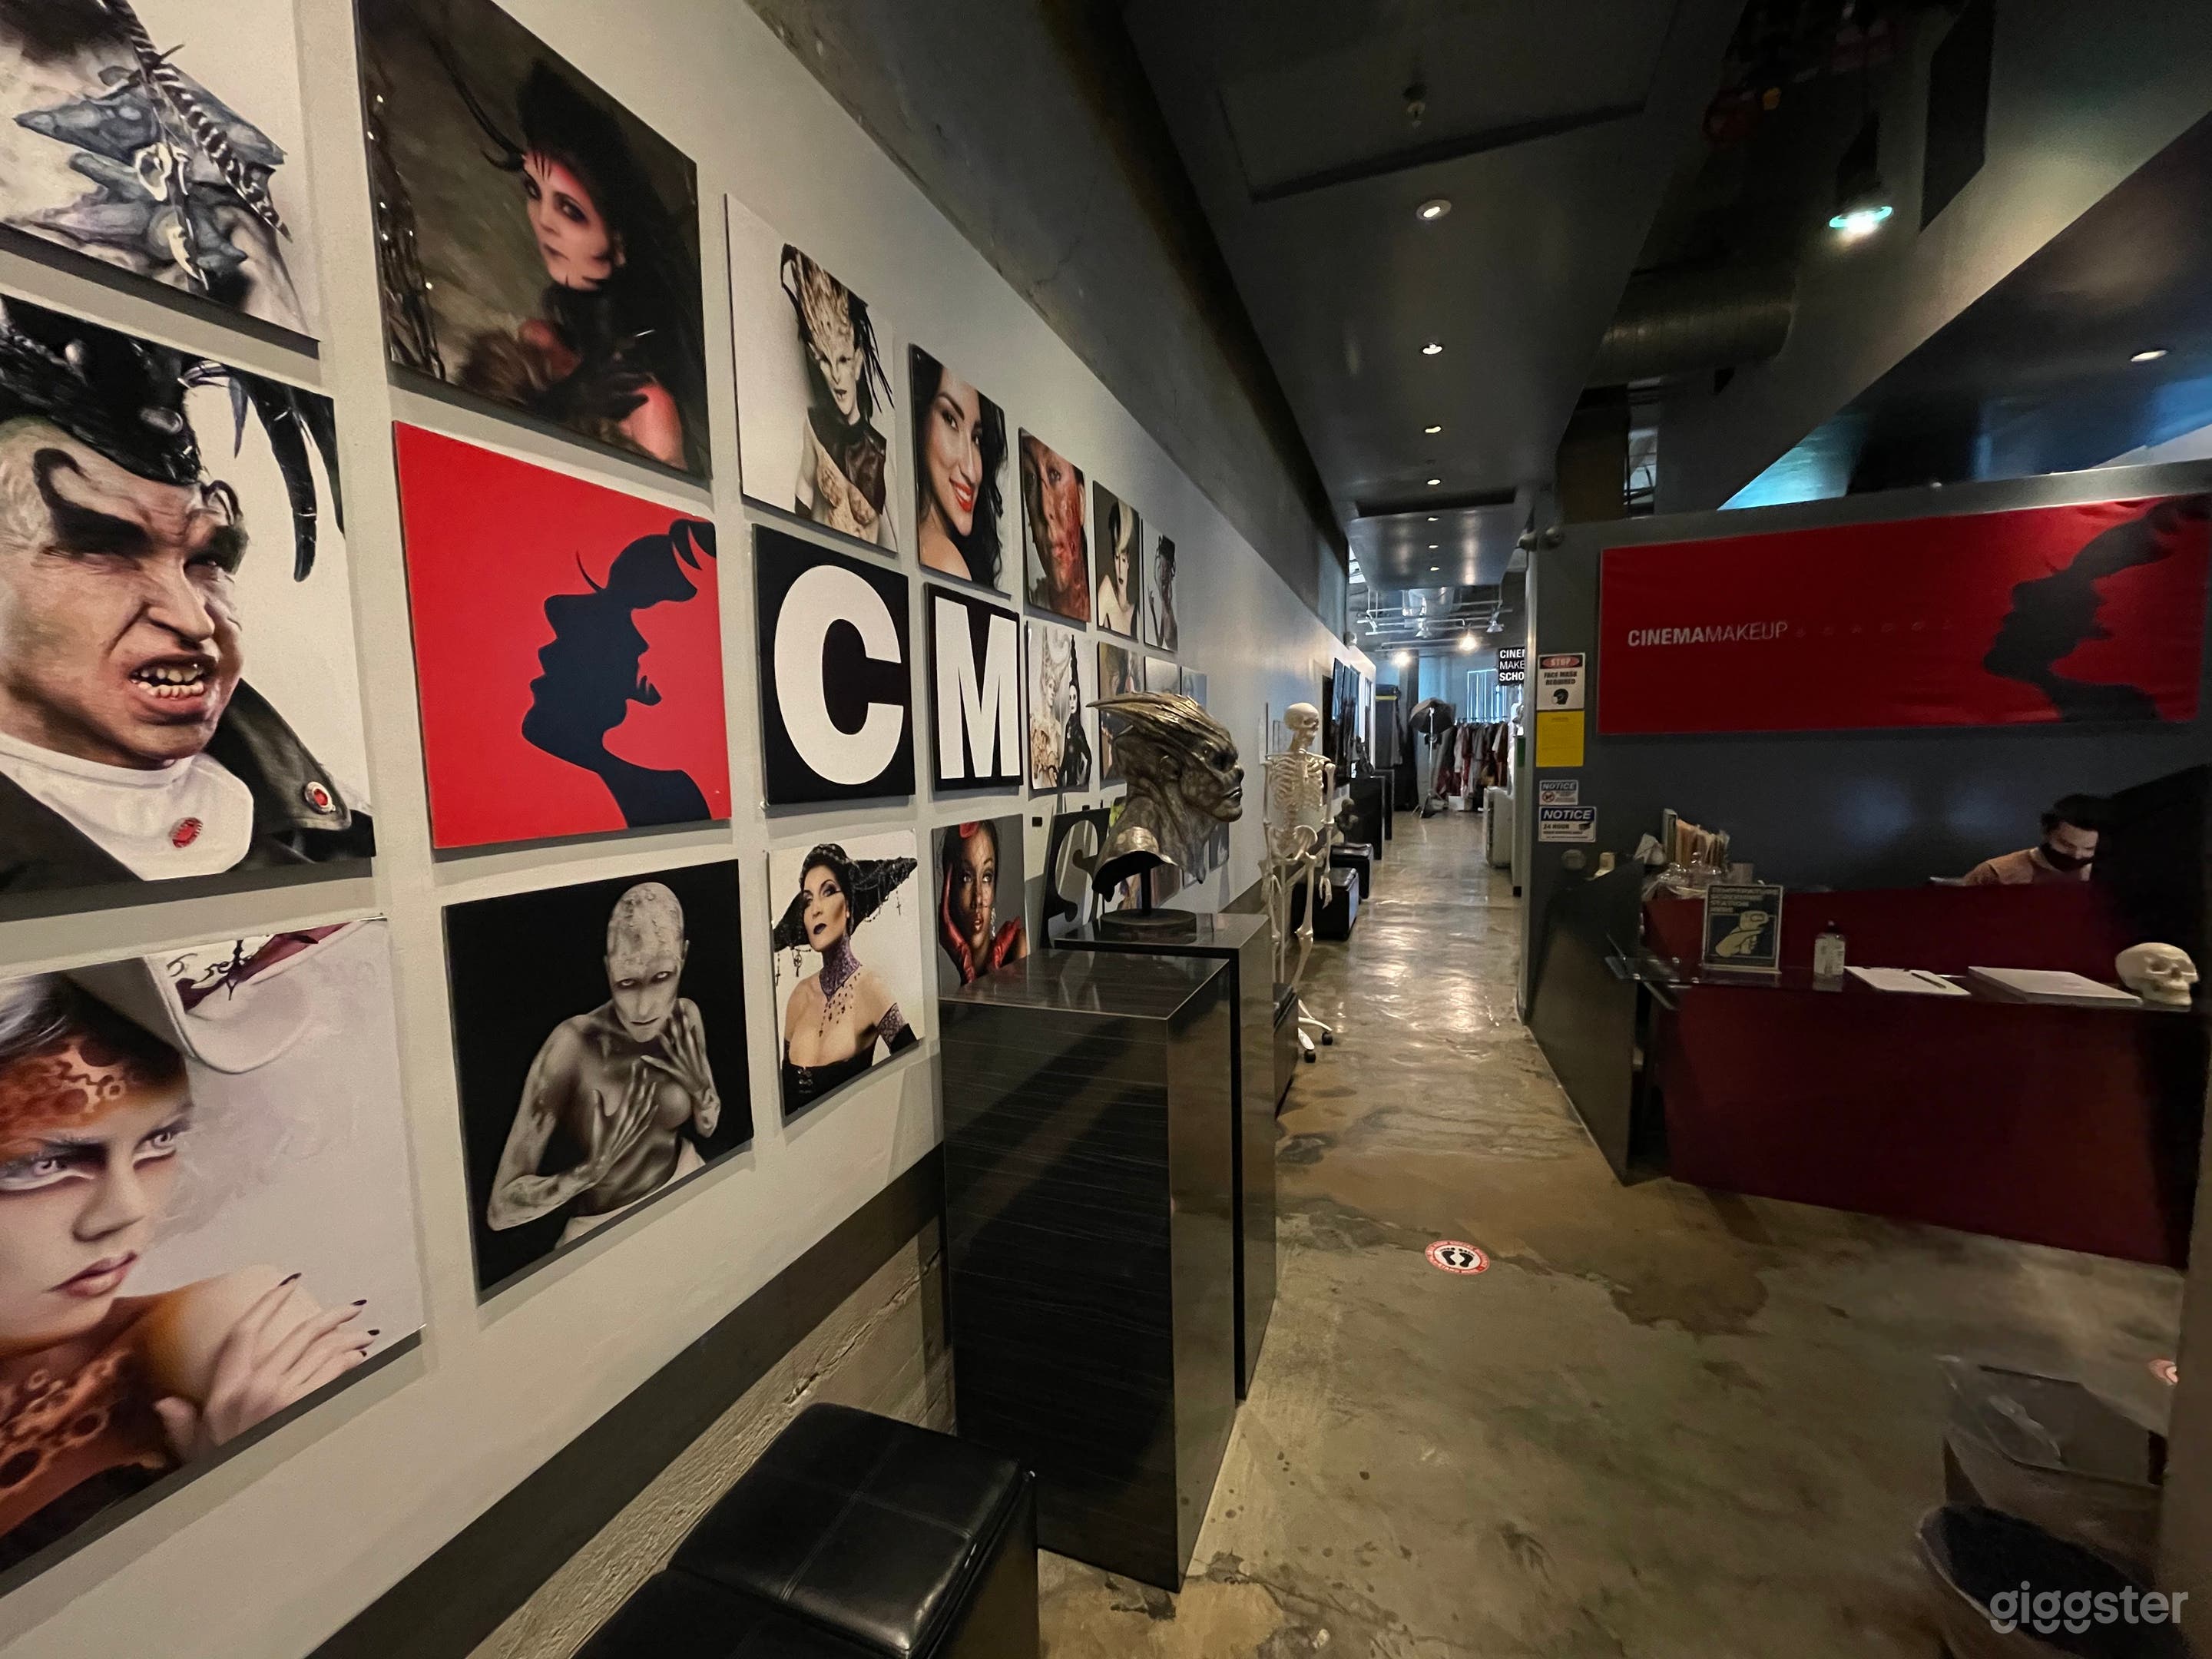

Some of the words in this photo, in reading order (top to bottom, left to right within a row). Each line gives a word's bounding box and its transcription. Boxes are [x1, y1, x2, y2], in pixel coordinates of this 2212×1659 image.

[774, 565, 904, 785] C
[935, 596, 1021, 780] M
[1543, 810, 1592, 820] NOTICE
